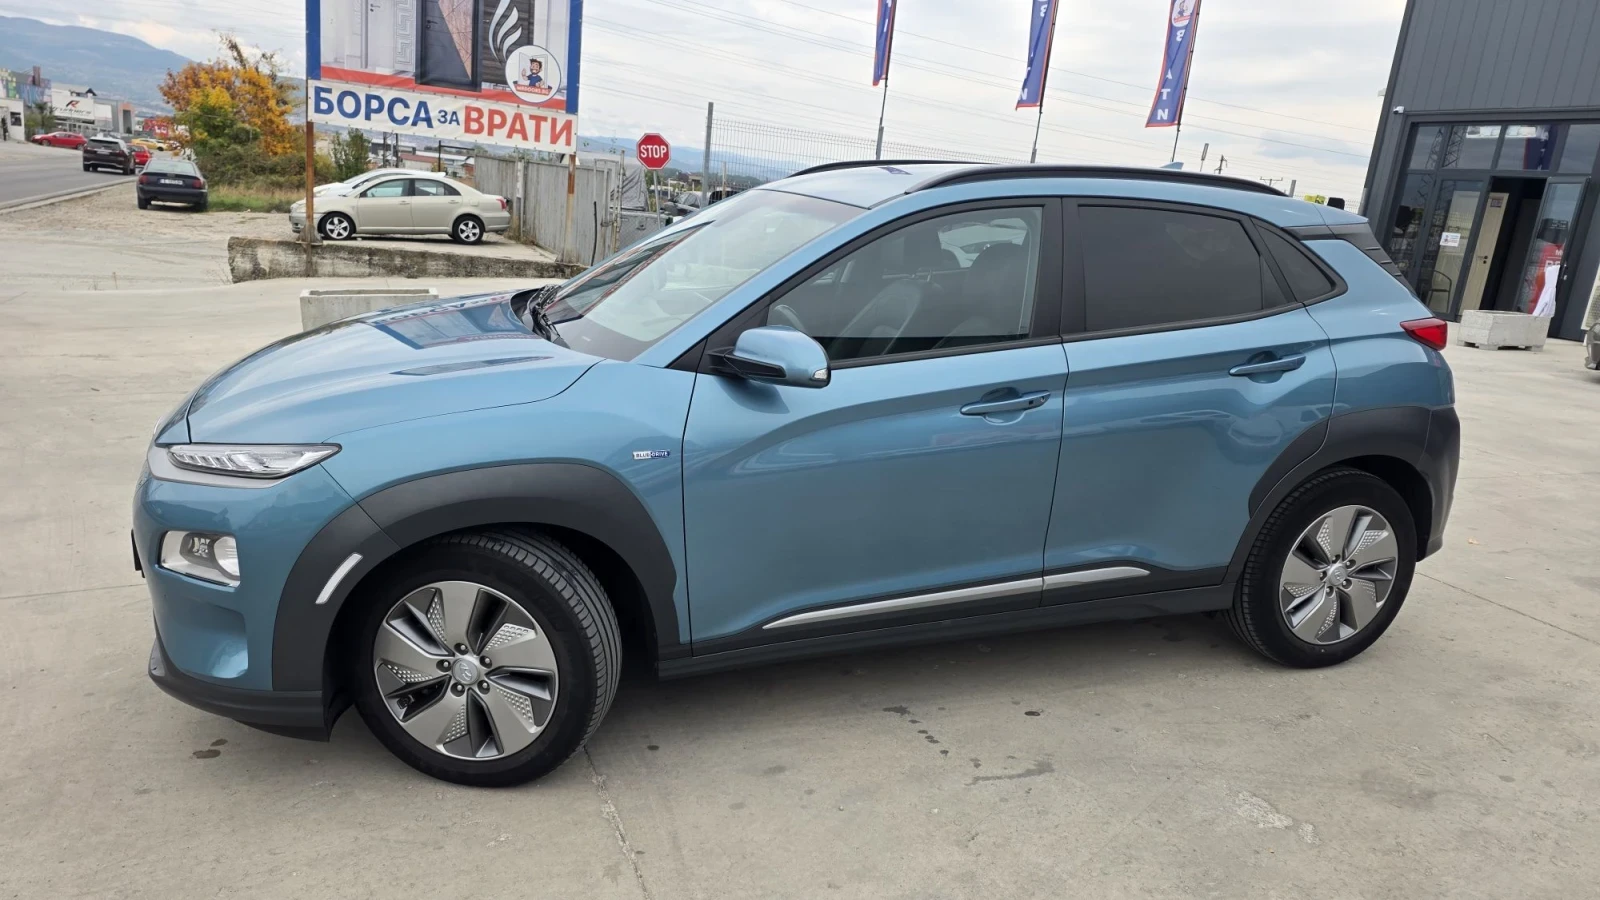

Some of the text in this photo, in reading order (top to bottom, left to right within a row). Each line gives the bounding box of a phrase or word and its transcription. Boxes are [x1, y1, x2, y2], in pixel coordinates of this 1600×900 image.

[313, 86, 434, 129] БОРСА
[463, 105, 573, 147] ВРАТИ
[640, 144, 667, 158] STOP
